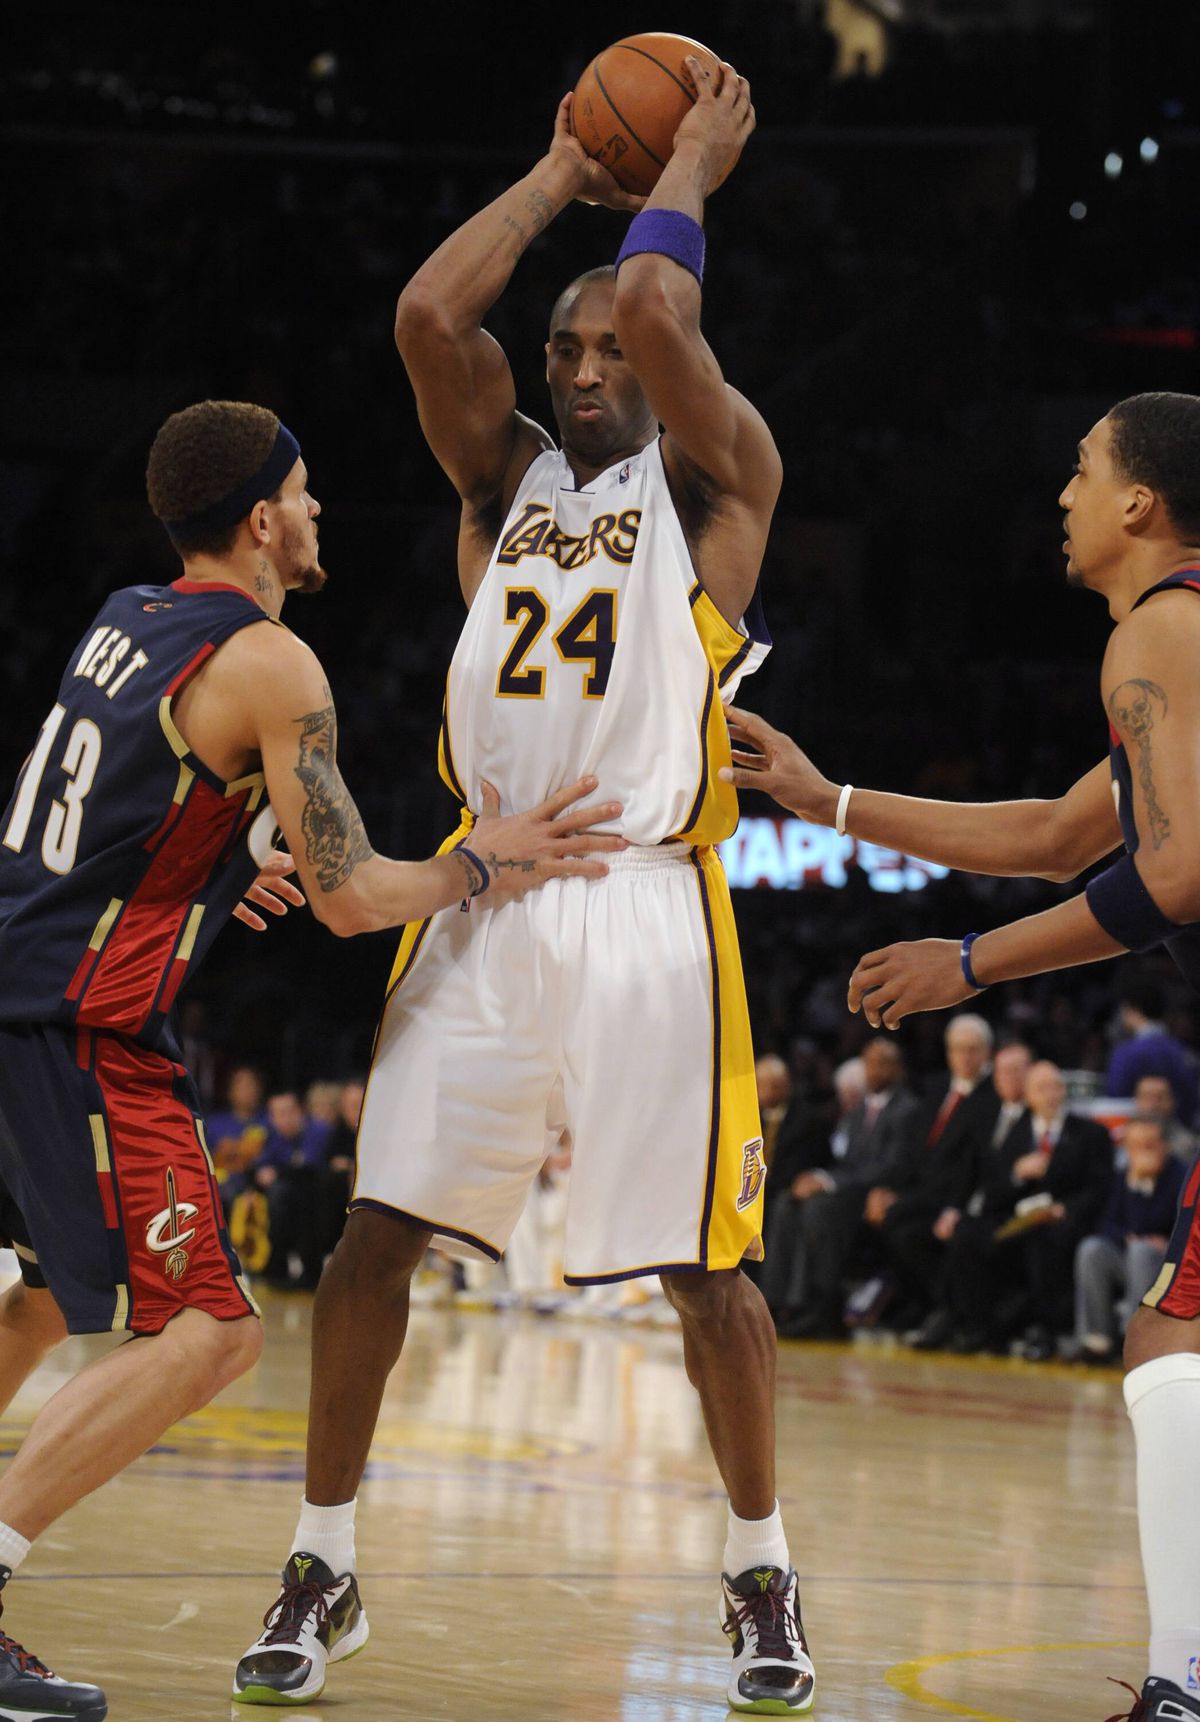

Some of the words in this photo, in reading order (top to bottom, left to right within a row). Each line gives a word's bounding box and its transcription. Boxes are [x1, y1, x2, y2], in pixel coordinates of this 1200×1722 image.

[496, 503, 643, 571] LAKERS
[73, 626, 149, 699] WEST
[495, 586, 618, 699] 24
[2, 702, 102, 876] 13
